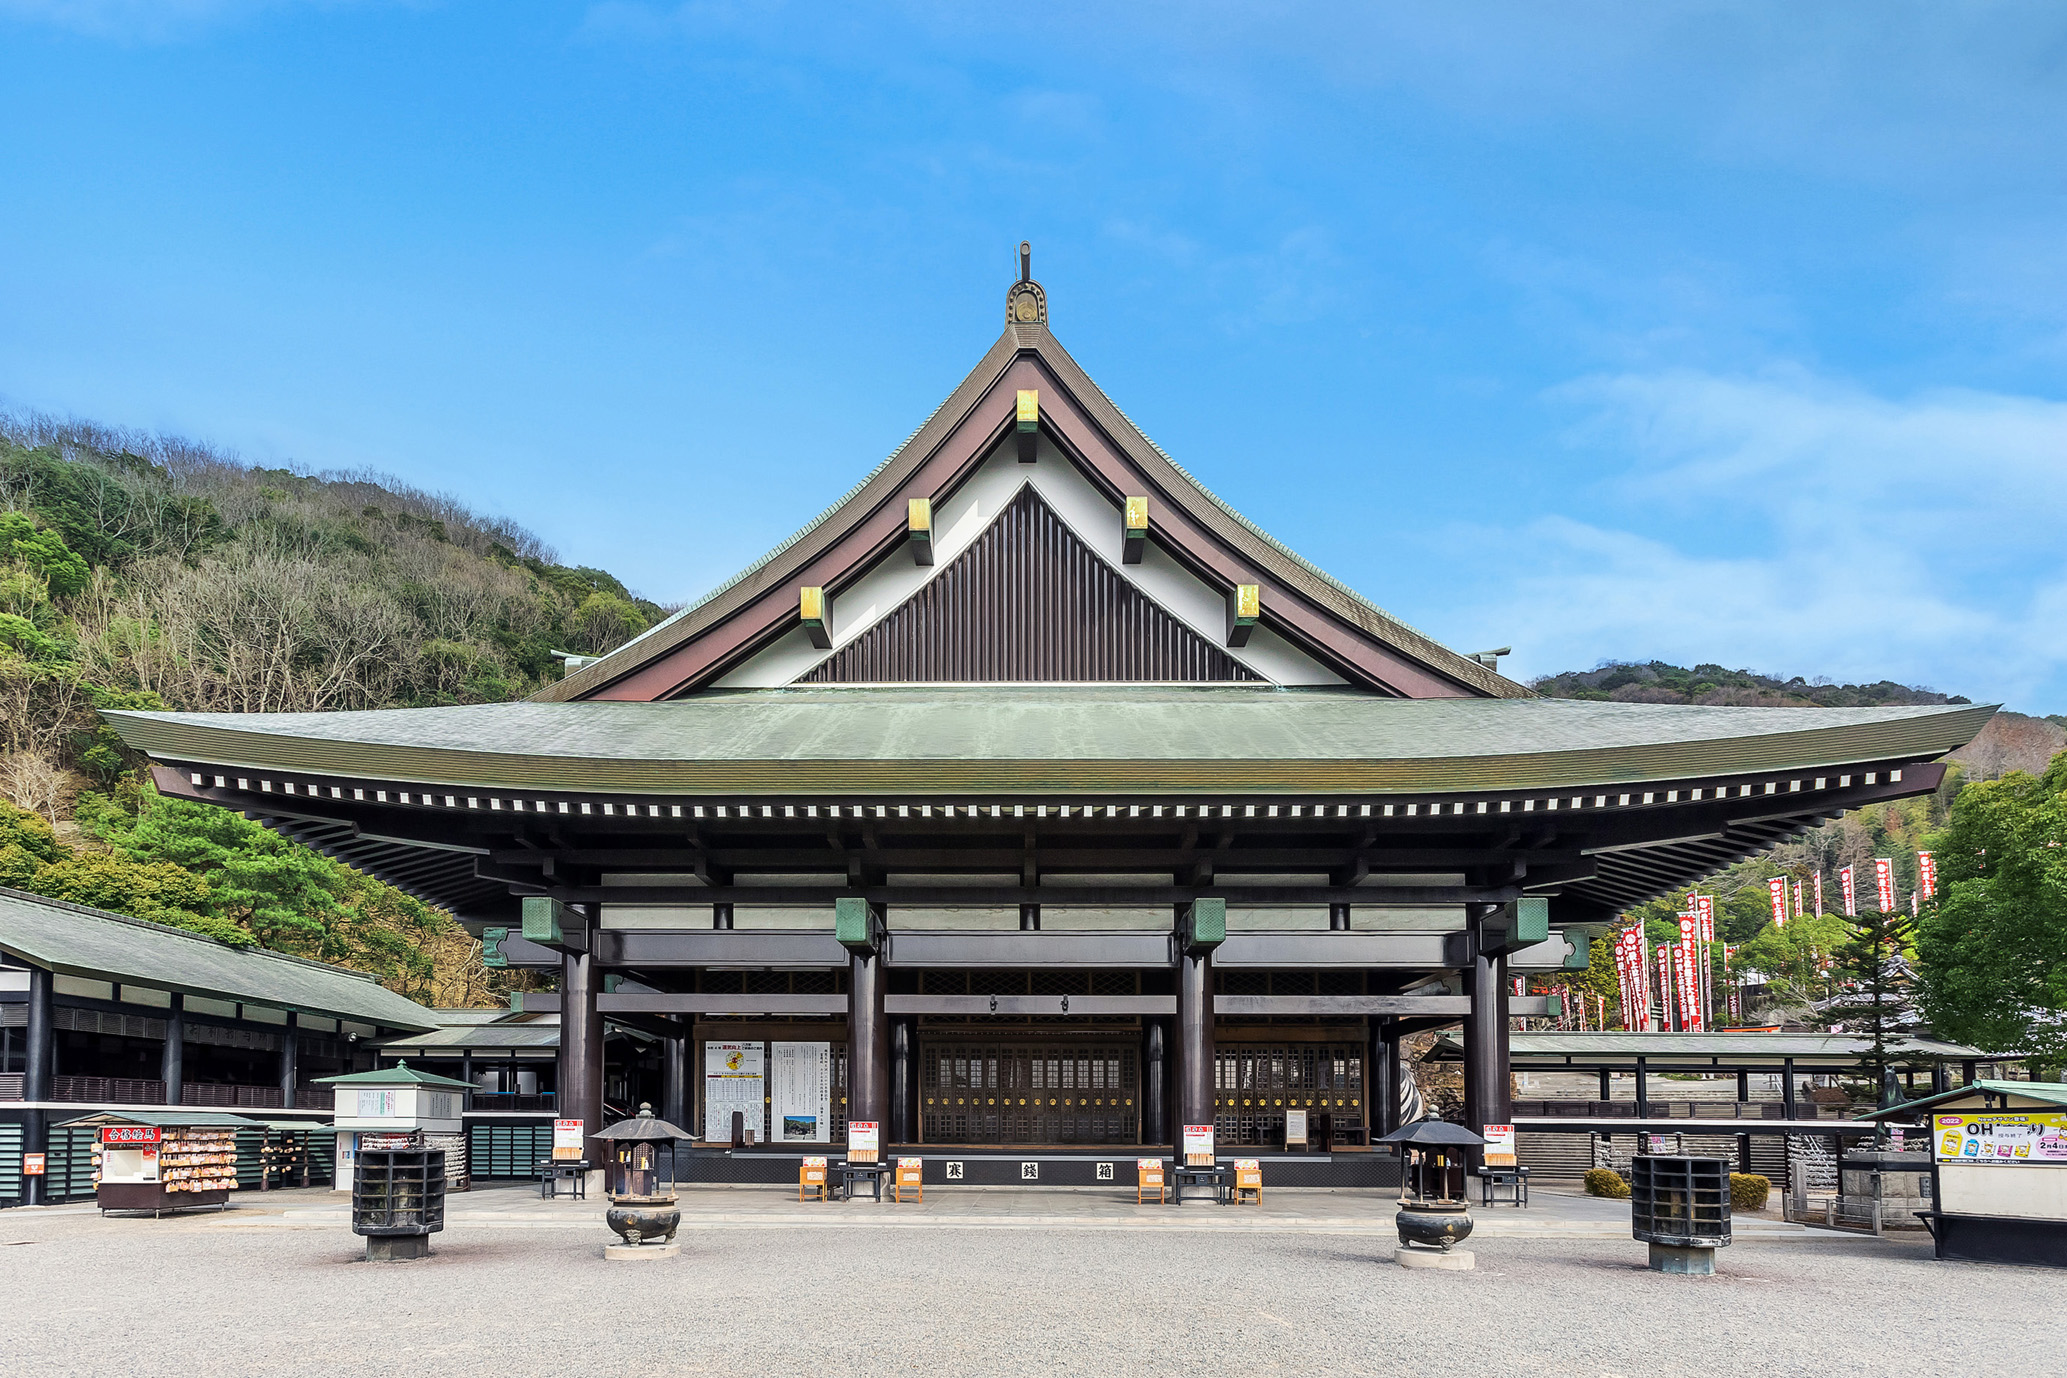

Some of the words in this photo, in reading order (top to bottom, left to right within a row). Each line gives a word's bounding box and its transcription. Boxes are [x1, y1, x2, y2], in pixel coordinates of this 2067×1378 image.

[108, 1128, 156, 1141] 合格絵馬
[1098, 1164, 1112, 1178] 箱
